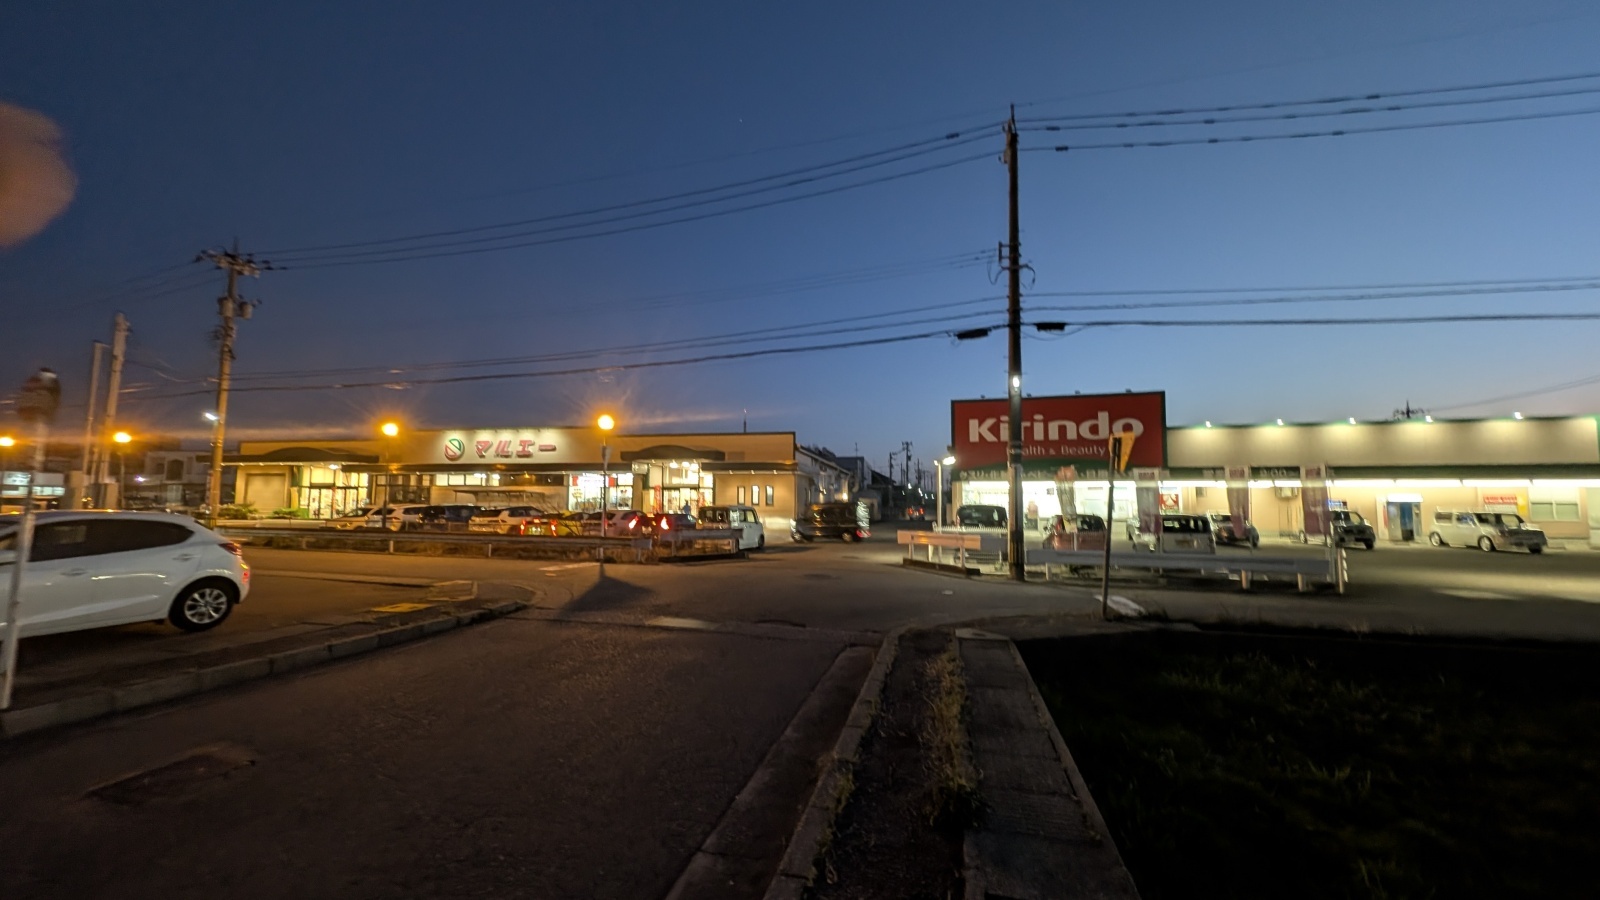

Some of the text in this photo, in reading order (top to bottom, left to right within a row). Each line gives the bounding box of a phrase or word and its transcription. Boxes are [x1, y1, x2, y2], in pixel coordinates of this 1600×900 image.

[475, 440, 557, 458] マルエー
[1061, 444, 1106, 457] Beauty
